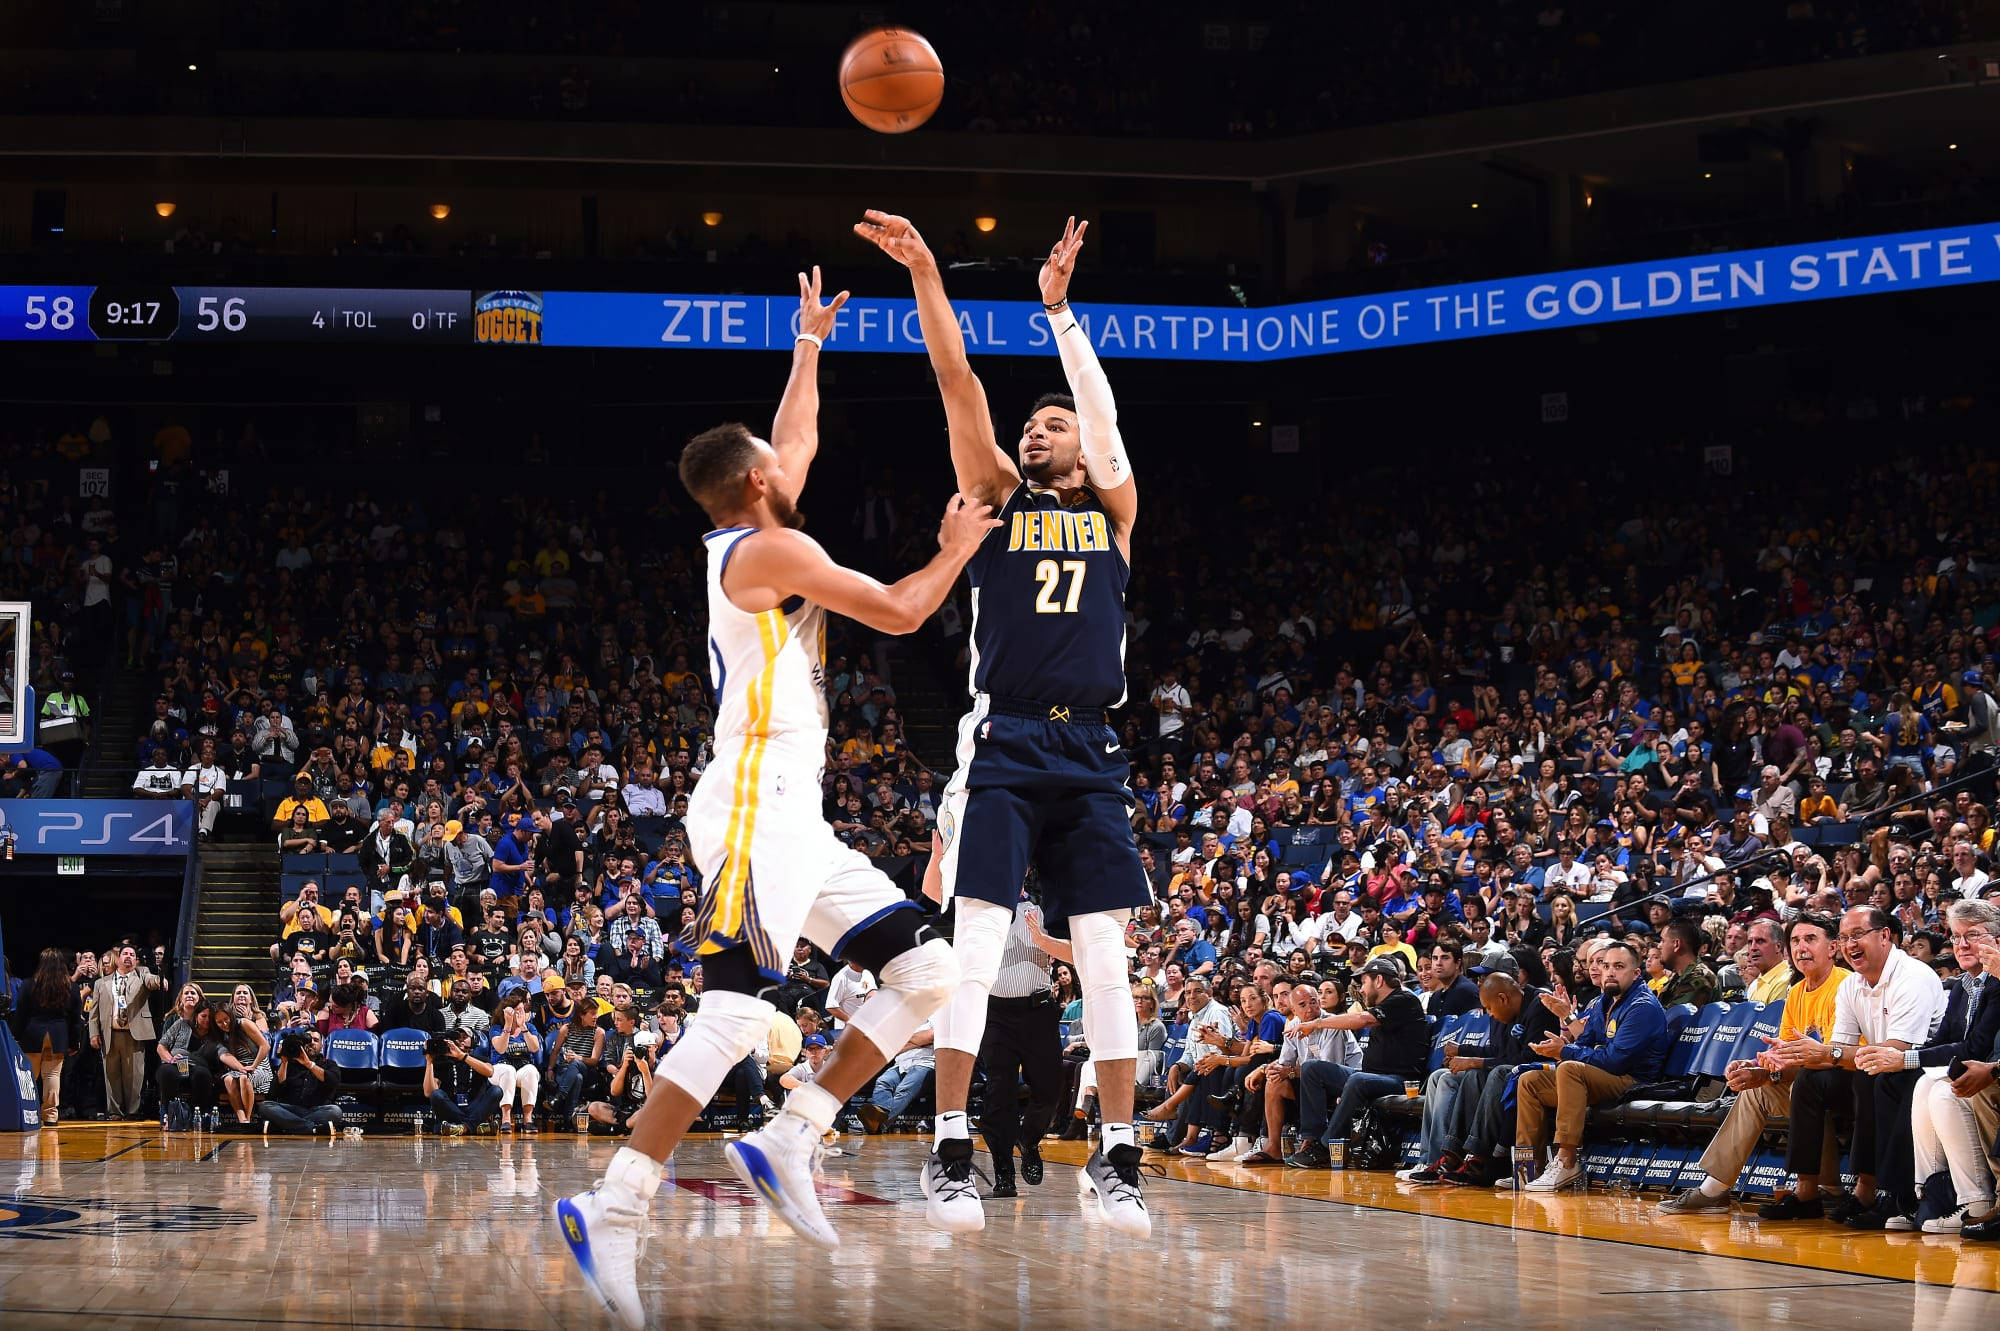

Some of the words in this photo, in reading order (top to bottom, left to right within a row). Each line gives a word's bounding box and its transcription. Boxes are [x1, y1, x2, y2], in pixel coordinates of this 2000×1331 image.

[1358, 302, 1409, 339] OF
[1426, 290, 1505, 331] THE
[1525, 261, 1764, 319] GOLDEN
[1790, 238, 1972, 291] STATE
[483, 299, 540, 312] DENVER
[25, 296, 75, 331] 58
[106, 302, 161, 325] 9:17
[197, 296, 247, 332] 56
[312, 311, 325, 329] 4
[342, 310, 377, 328] TOL
[412, 312, 426, 330] 0
[436, 312, 458, 329] TF
[661, 299, 747, 342] ZTE
[81, 481, 107, 495] 107
[1007, 511, 1111, 552] DENVER
[1035, 559, 1087, 613] 27
[38, 812, 179, 845] PS4
[62, 856, 81, 872] EXIT
[1587, 1155, 1617, 1165] AMERICAN
[1617, 1157, 1649, 1167] AMERICAN
[1650, 1159, 1682, 1169] AMERICAN
[1585, 1164, 1608, 1174] XPRESS
[1612, 1166, 1640, 1176] EXPRESS
[1645, 1169, 1673, 1178] EXPRESS
[1678, 1171, 1707, 1181] EXPRESS
[1752, 1165, 1787, 1177] AMERICAN
[1748, 1176, 1778, 1187] EXPRESS
